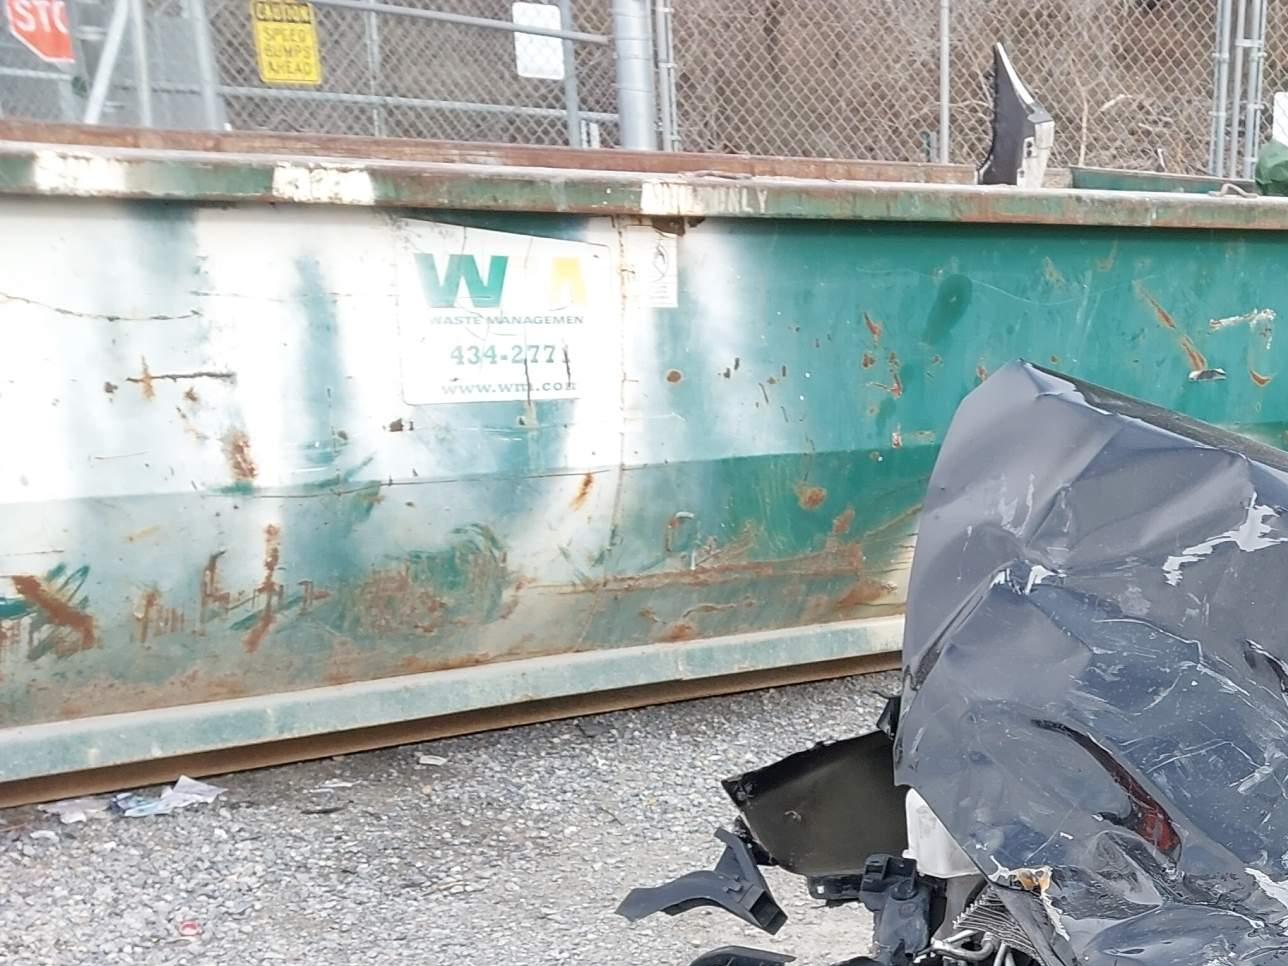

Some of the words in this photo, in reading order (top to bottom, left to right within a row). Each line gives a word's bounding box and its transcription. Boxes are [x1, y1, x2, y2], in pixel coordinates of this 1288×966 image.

[14, 0, 69, 33] STO
[263, 27, 306, 43] SPEED
[263, 43, 312, 59] BUMPS
[267, 60, 312, 75] AHEAD
[431, 315, 481, 326] WASTE
[487, 315, 585, 325] MANAGEMEN
